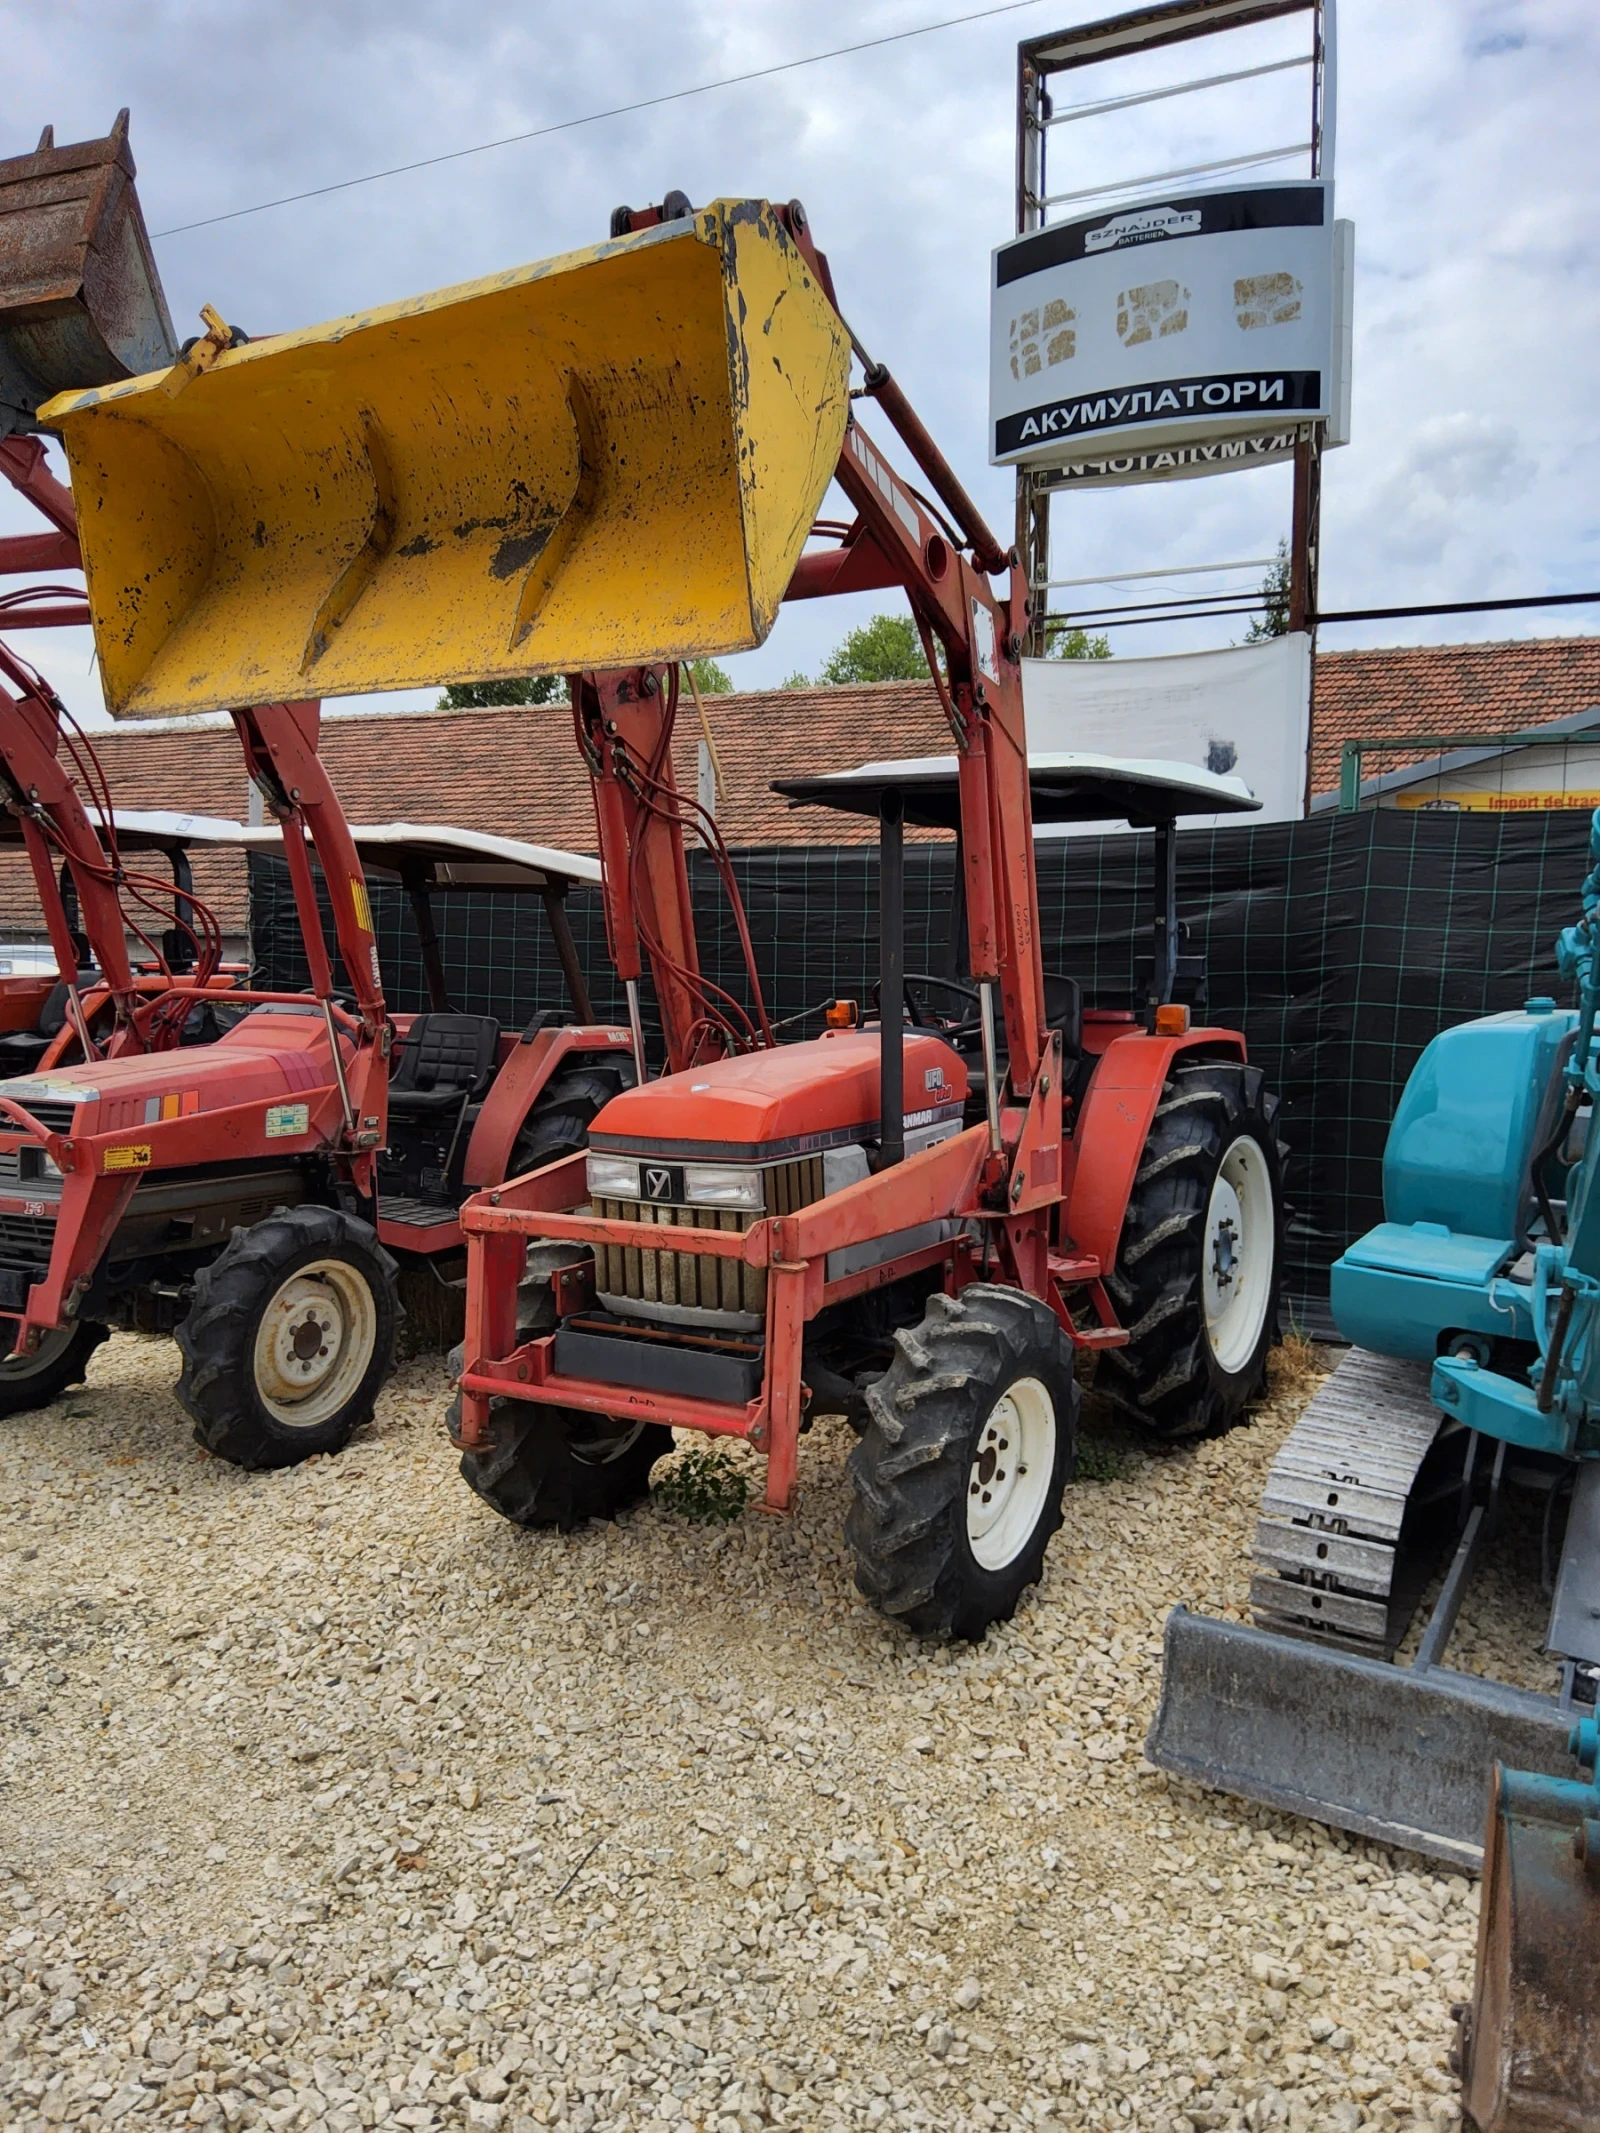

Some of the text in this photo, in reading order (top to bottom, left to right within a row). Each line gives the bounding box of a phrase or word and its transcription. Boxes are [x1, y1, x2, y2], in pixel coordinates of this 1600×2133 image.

[1091, 214, 1194, 241] SZNAJDER
[1118, 231, 1165, 246] BATTERIEN
[1019, 378, 1285, 441] АКУМУЛАТОРИ
[1488, 795, 1600, 810] Import de trac
[925, 1068, 943, 1092] UFO
[903, 1109, 933, 1129] ANMAR
[24, 1201, 45, 1217] F3
